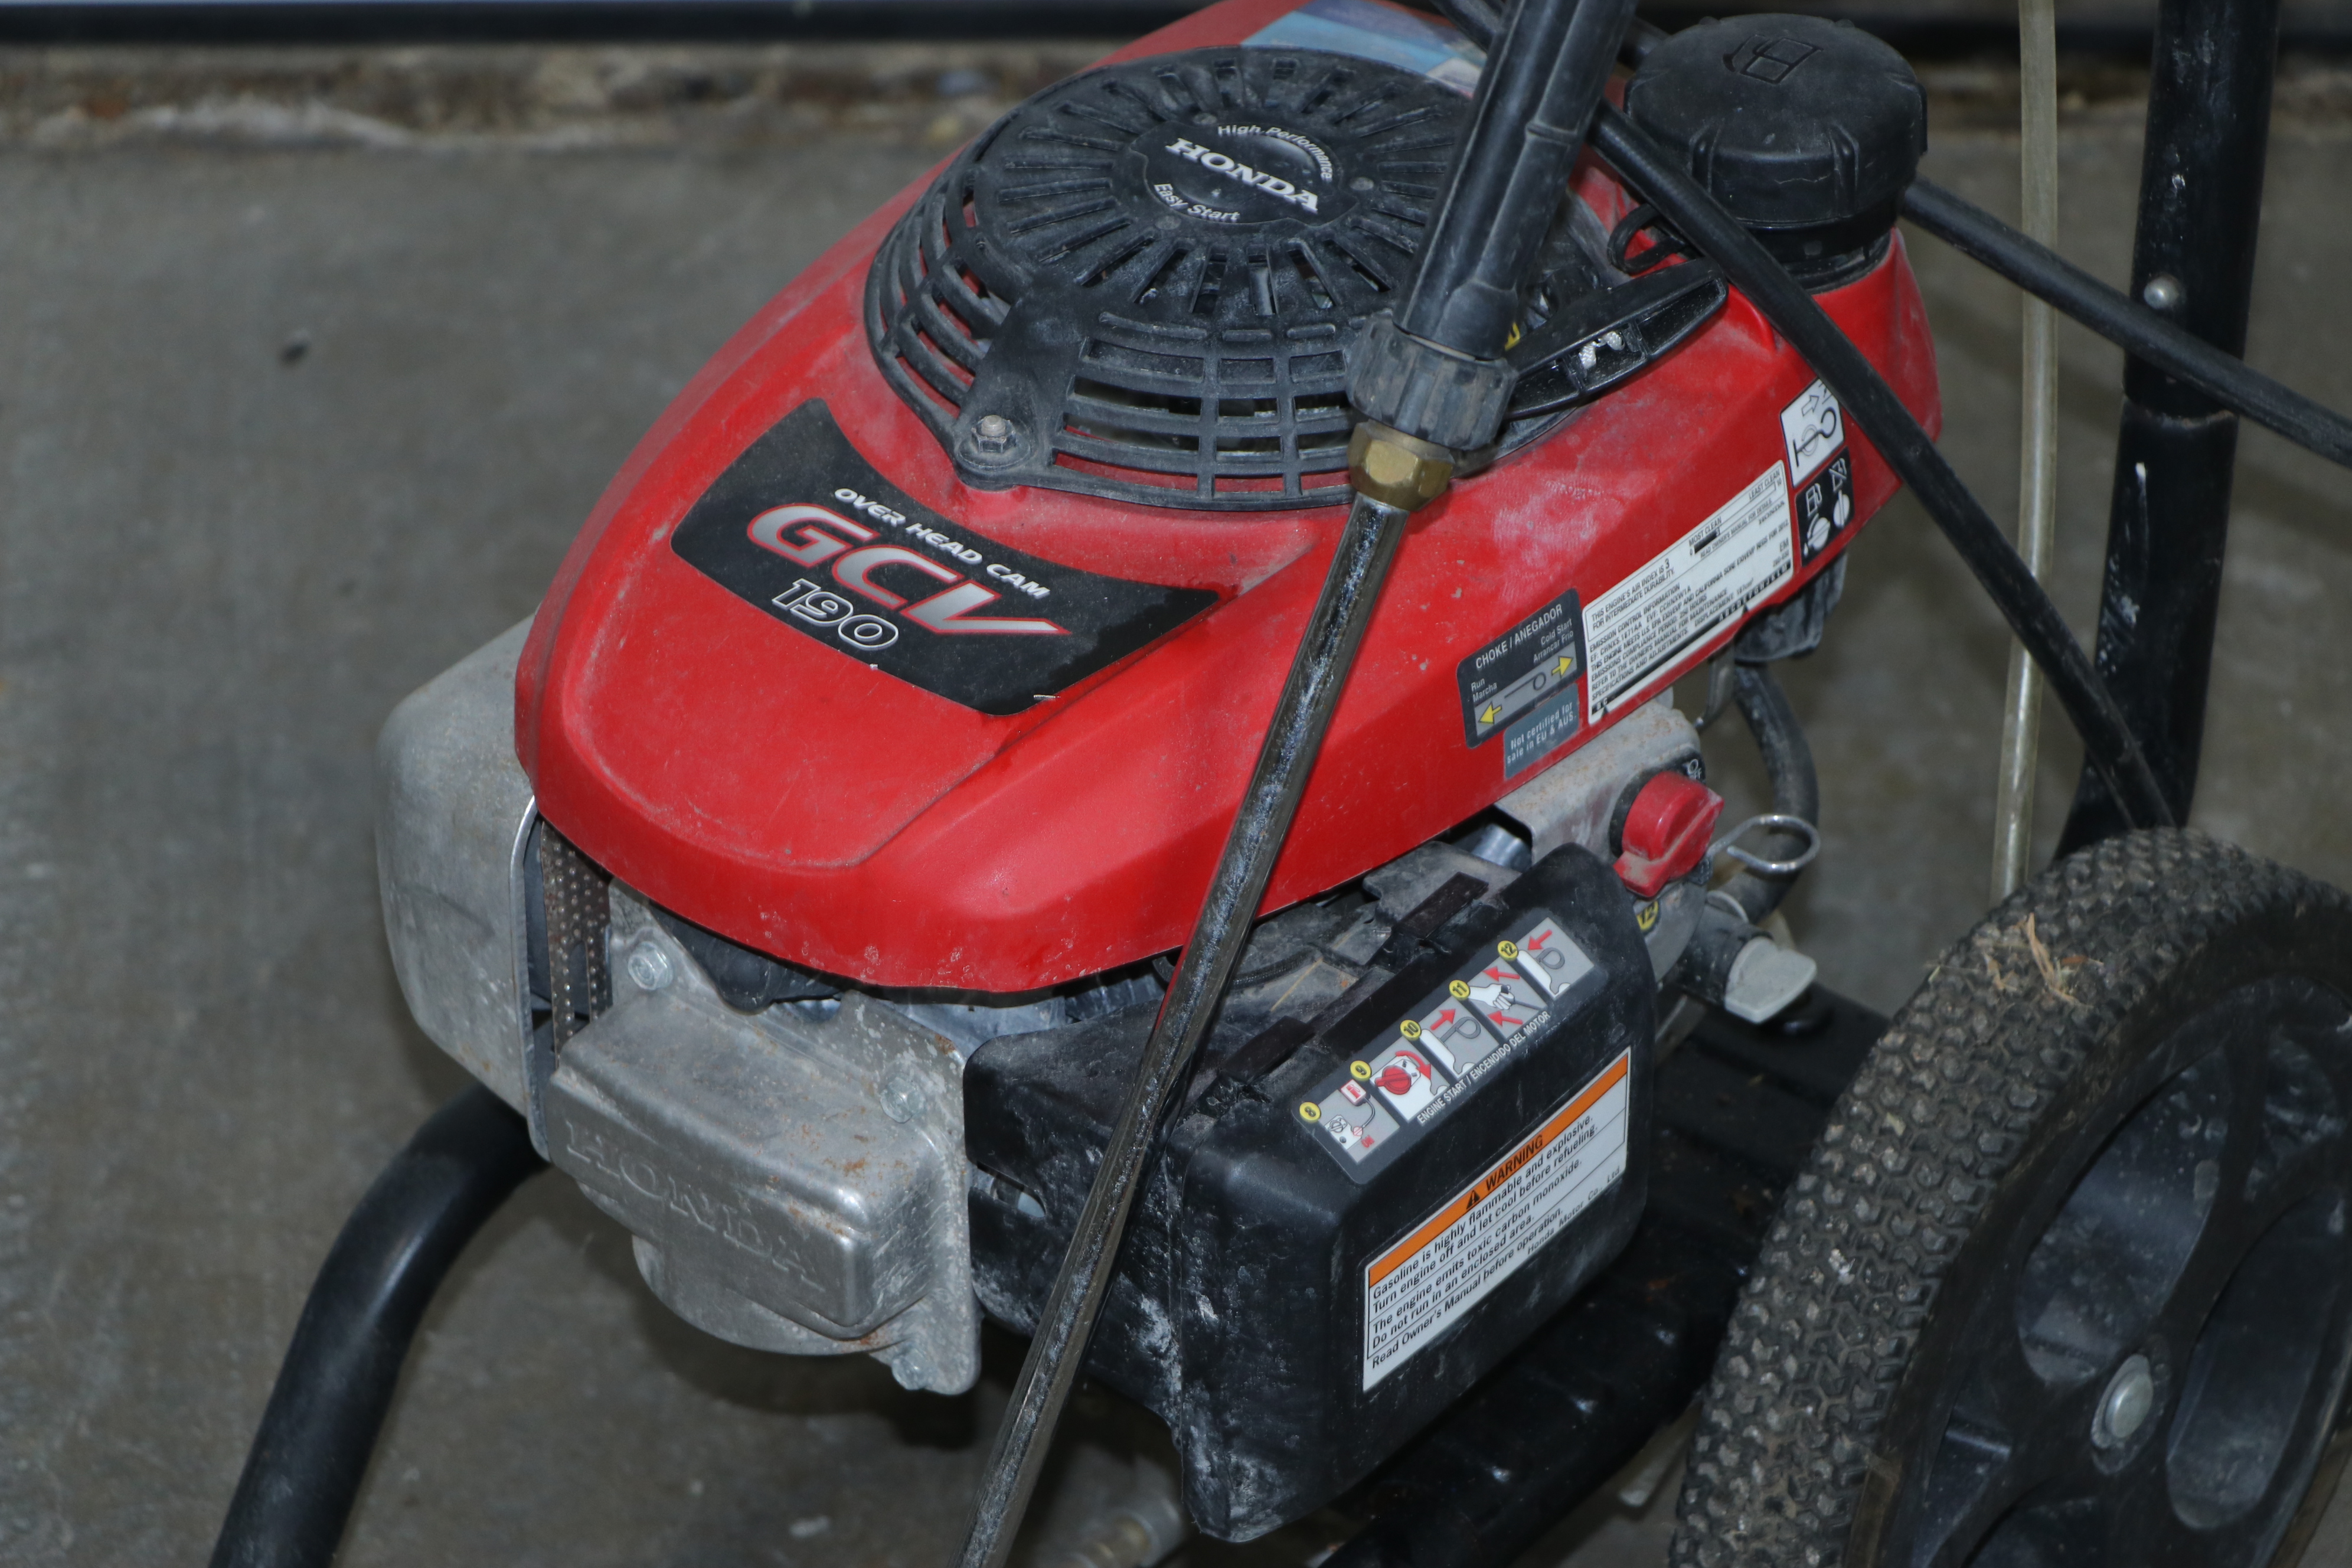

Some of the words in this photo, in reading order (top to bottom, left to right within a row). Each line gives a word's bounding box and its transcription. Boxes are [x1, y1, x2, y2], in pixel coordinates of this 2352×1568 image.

[1165, 138, 1318, 214] HONDA
[1218, 125, 1261, 136] High
[1266, 126, 1332, 182] Performance
[1154, 184, 1188, 210] Easy
[1187, 204, 1240, 223] Start
[1749, 483, 1764, 500] LEAST
[1765, 469, 1781, 486] CLEAN
[1758, 500, 1785, 525] HONDA
[834, 488, 906, 526] OVER
[906, 522, 982, 564] HEAD
[986, 563, 1050, 599] CAM
[1688, 532, 1704, 547] MOST
[1705, 516, 1722, 534] CLEAN
[1779, 537, 1789, 553] EM
[747, 502, 1072, 635] GCV
[1592, 609, 1605, 620] THIS
[1605, 592, 1631, 613] ENGINE'S
[1632, 583, 1641, 593] AIR
[1642, 571, 1658, 587] INDEX
[1659, 565, 1664, 575] IS
[1665, 558, 1670, 569] 3
[772, 578, 899, 649] 190
[1476, 640, 1508, 669] CHOKE
[1509, 639, 1514, 649] /
[1514, 604, 1563, 646] ANEGADOR
[1541, 629, 1556, 646] Cold
[1557, 618, 1572, 636] Start
[1590, 629, 1616, 652] EMISSION
[1618, 610, 1642, 633] CONTROL
[1643, 583, 1680, 615] INFORMATION
[1591, 661, 1603, 672] THIS
[1603, 646, 1623, 662] ENGINE
[1623, 633, 1641, 649] MEETS
[1652, 619, 1661, 629] EPA
[1683, 594, 1694, 606] AND
[1695, 571, 1723, 597] CALIFORNIA
[1592, 658, 1621, 682] EMISSIONS
[1623, 633, 1656, 659] COMPLIANCE
[1690, 593, 1707, 610] HOURS
[1592, 677, 1608, 691] REFER
[1609, 669, 1616, 678] TO
[1618, 661, 1628, 672] THE
[1629, 644, 1653, 665] OWNER'S
[1654, 626, 1677, 646] MANUAL
[1679, 617, 1689, 629] FOR
[1690, 587, 1727, 620] MAINTENANCE
[1593, 619, 1605, 631] FOR
[1605, 591, 1643, 622] INTERMEDIATE
[1533, 641, 1560, 663] Arrancar
[1592, 667, 1634, 701] SPECIFICATIONS
[1635, 658, 1648, 669] AND
[1471, 678, 1485, 691] Run
[1473, 682, 1498, 702] Marcha
[1507, 747, 1524, 765] sale
[1527, 739, 1534, 750] in
[1536, 730, 1547, 744] EU
[1550, 724, 1556, 734] &
[1558, 713, 1577, 730] AUS.
[1510, 735, 1525, 750] Not
[1527, 710, 1560, 741] certified
[1562, 701, 1573, 718] for
[1501, 943, 1517, 956] 12
[1452, 982, 1467, 995] 11
[1403, 1022, 1419, 1036] 10
[1355, 1065, 1367, 1076] 9
[1417, 1097, 1446, 1124] ENGINE
[1443, 1079, 1467, 1102] START
[1466, 1074, 1471, 1084] /
[1470, 1043, 1511, 1080] ENCENDIDO
[1509, 1032, 1525, 1047] DEL
[1523, 1011, 1551, 1035] MOTOR
[1305, 1106, 1316, 1117] 8
[1485, 1134, 1543, 1191] WARNING
[1373, 1260, 1419, 1299] Gasoline
[1422, 1250, 1431, 1262] is
[1435, 1220, 1466, 1253] highly
[1469, 1175, 1522, 1225] flammable
[1525, 1158, 1543, 1178] and
[1547, 1115, 1593, 1160] explosive.
[1373, 1290, 1397, 1314] Turn
[1400, 1262, 1436, 1293] engine
[1440, 1245, 1455, 1262] off
[1457, 1228, 1476, 1249] and
[1479, 1215, 1492, 1231] let
[1495, 1191, 1516, 1217] cool
[1520, 1165, 1551, 1197] before
[1554, 1124, 1598, 1168] refueling.
[1528, 1227, 1554, 1255] Honda
[1559, 1201, 1584, 1227] Motor
[1608, 1165, 1622, 1183] Ltd.
[1373, 1314, 1393, 1334] The
[1397, 1284, 1432, 1317] engine
[1436, 1257, 1464, 1286] emits
[1468, 1235, 1492, 1260] toxic
[1495, 1203, 1530, 1237] carbon
[1533, 1158, 1582, 1206] monoxide.
[1373, 1332, 1387, 1349] Do
[1391, 1315, 1407, 1335] not
[1411, 1299, 1429, 1319] run
[1432, 1289, 1441, 1302] in
[1445, 1277, 1458, 1292] an
[1462, 1233, 1507, 1279] enclosed
[1510, 1215, 1534, 1239] area.
[1373, 1340, 1399, 1368] Read
[1402, 1309, 1441, 1344] Owner's
[1445, 1274, 1481, 1312] Manual
[1484, 1249, 1514, 1280] before
[1517, 1207, 1563, 1251] operation.
